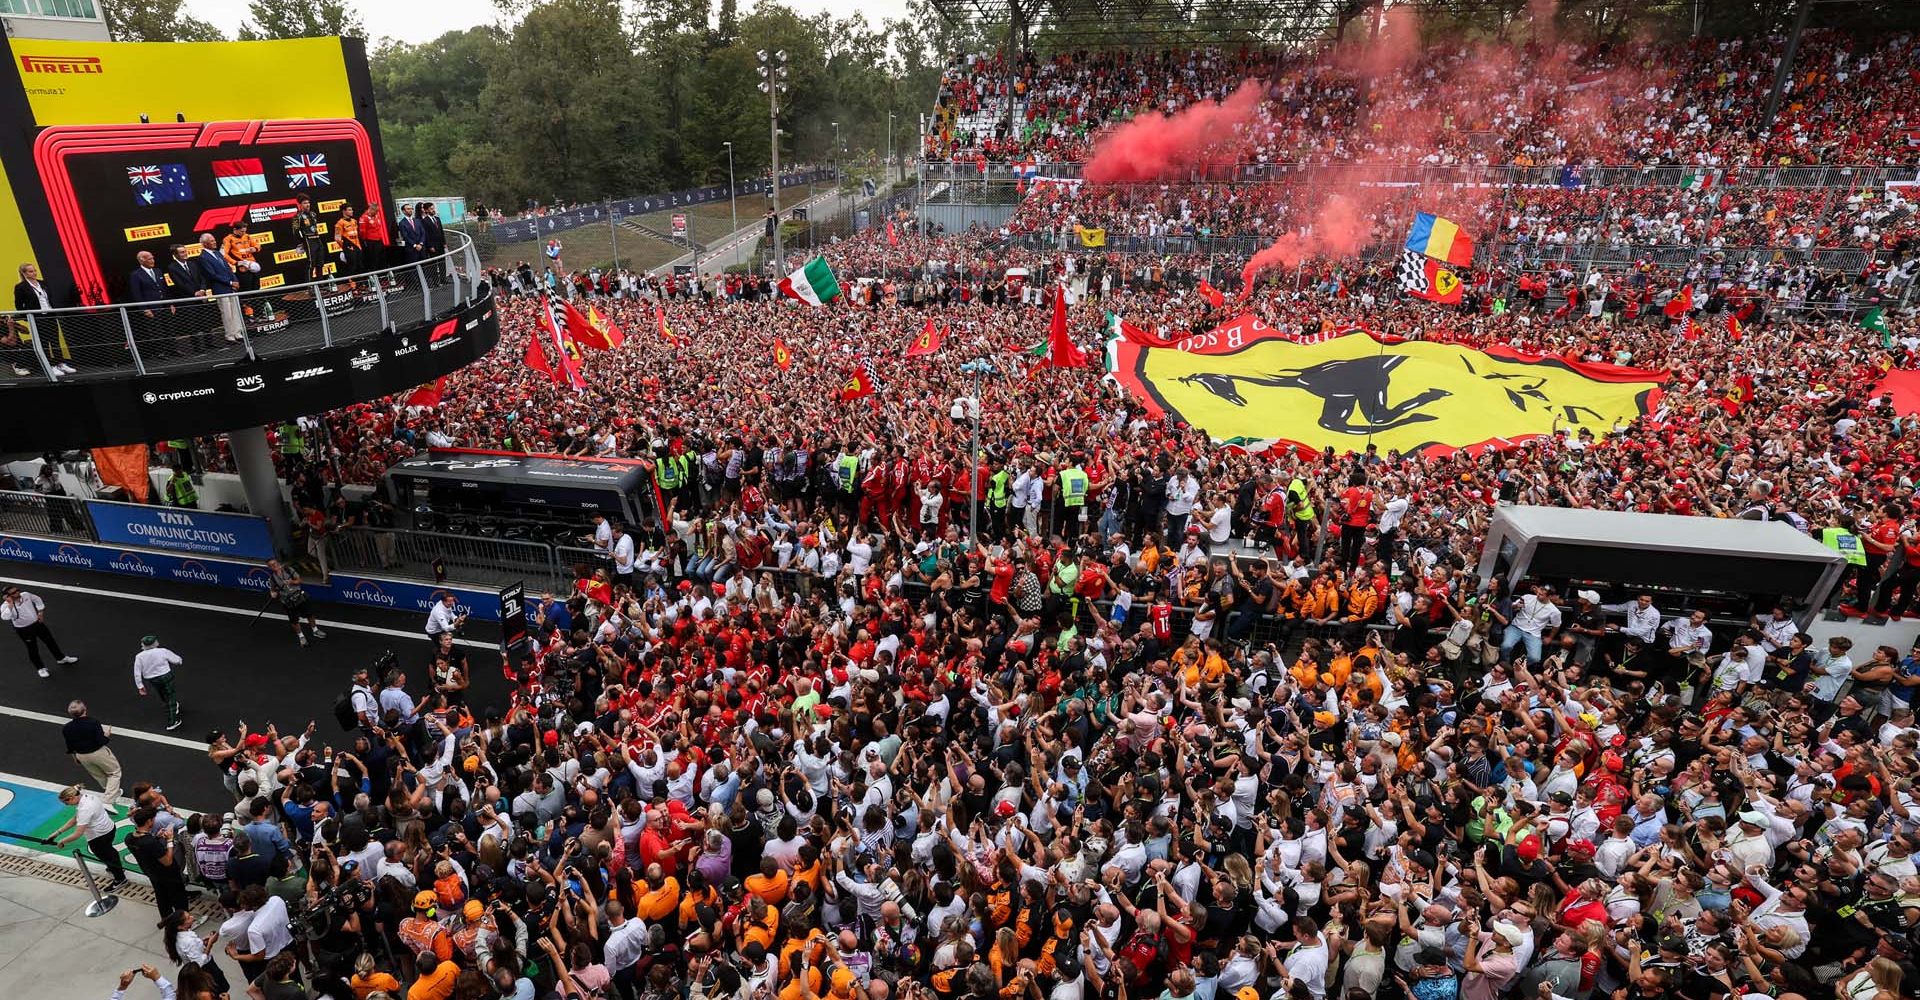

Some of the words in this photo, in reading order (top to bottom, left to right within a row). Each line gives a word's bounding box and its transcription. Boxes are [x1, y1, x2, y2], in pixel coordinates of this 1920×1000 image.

[20, 55, 103, 73] PIRELLI
[130, 226, 165, 239] PIRELLI
[395, 344, 418, 357] ROLEX
[352, 355, 378, 366] Heineken
[236, 374, 263, 388] aws
[158, 387, 215, 401] crypto.com
[157, 512, 194, 526] TATA
[127, 523, 236, 545] COMMUNICATIONS
[149, 538, 220, 552] #EmpoweringTomorrow
[0, 546, 33, 561] orkday
[49, 552, 93, 568] workday
[109, 560, 154, 576] workday
[172, 568, 218, 584] workday
[342, 589, 395, 606] workday
[502, 587, 521, 601] ITALY
[416, 599, 471, 614] woday
[505, 599, 521, 619] 1
